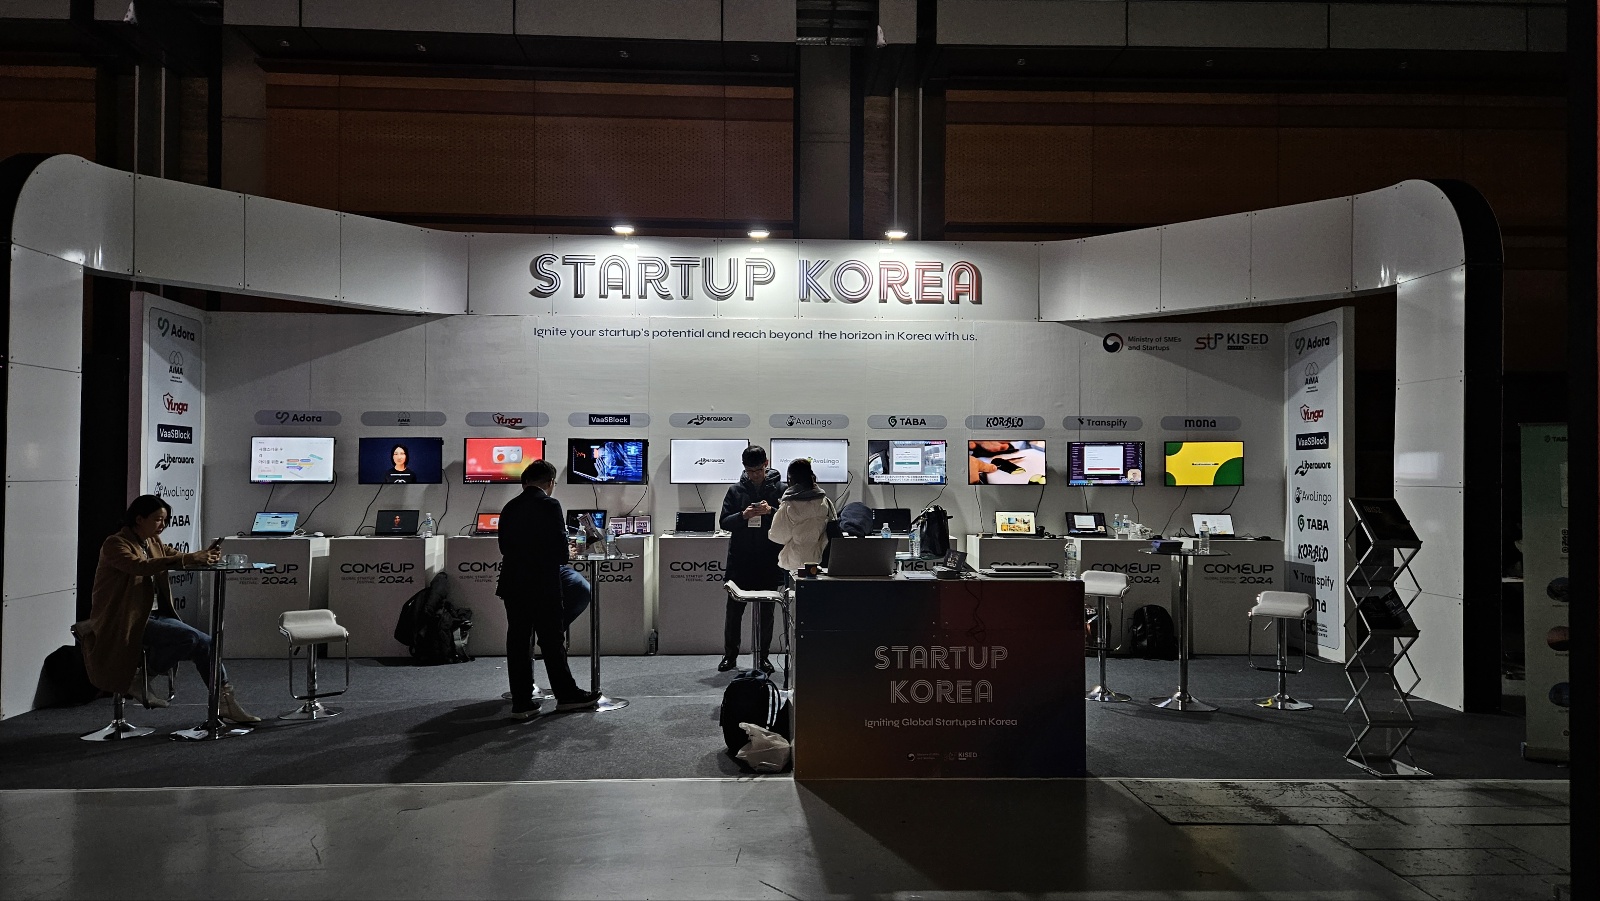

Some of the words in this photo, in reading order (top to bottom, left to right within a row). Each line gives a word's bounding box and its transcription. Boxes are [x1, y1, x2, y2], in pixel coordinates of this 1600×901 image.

[529, 254, 776, 300] STARTUP
[798, 258, 983, 305] KOREA
[171, 324, 195, 341] Adora
[534, 327, 567, 338] Ignite
[570, 329, 596, 338] your
[599, 328, 649, 339] startup's
[652, 329, 705, 339] potential
[707, 329, 730, 338] and
[733, 330, 766, 339] reach
[770, 330, 813, 341] beyond
[818, 330, 838, 340] the
[840, 331, 882, 340] horizon
[885, 331, 895, 340] in
[898, 332, 931, 341] Korea
[934, 332, 959, 341] with
[962, 333, 978, 341] us.
[1128, 336, 1154, 344] Ministry
[1227, 333, 1269, 345] KISED
[1306, 336, 1330, 350] Adora
[1142, 344, 1170, 352] Startups
[166, 397, 188, 415] Yunga
[291, 413, 322, 423] Adora
[497, 414, 523, 426] Yunga
[591, 416, 628, 424] VaaSBlock
[1303, 408, 1324, 422] Yunga
[796, 417, 832, 427] AvoLingo
[900, 418, 926, 426] TABA
[1087, 418, 1128, 429] Transpify
[160, 428, 191, 440] VaaSBlock
[1297, 434, 1327, 447] VaaSBlock
[162, 485, 195, 500] AvoLingo
[1302, 490, 1332, 505] AvoLingo
[1306, 519, 1329, 531] TABA
[340, 562, 414, 573] COMEUP
[1204, 563, 1274, 574] COMEUP
[262, 576, 298, 585] 2024
[378, 576, 414, 584] 2024
[1129, 576, 1160, 584] 2024
[1239, 576, 1274, 585] 2024
[1300, 572, 1334, 591] Transpify
[874, 645, 1009, 670] STARTUP
[890, 679, 993, 704] KOREA
[864, 718, 900, 729] Igniting
[901, 717, 934, 727] Global
[935, 717, 977, 728] Startups
[978, 717, 987, 726] in
[988, 717, 1018, 726] Korea
